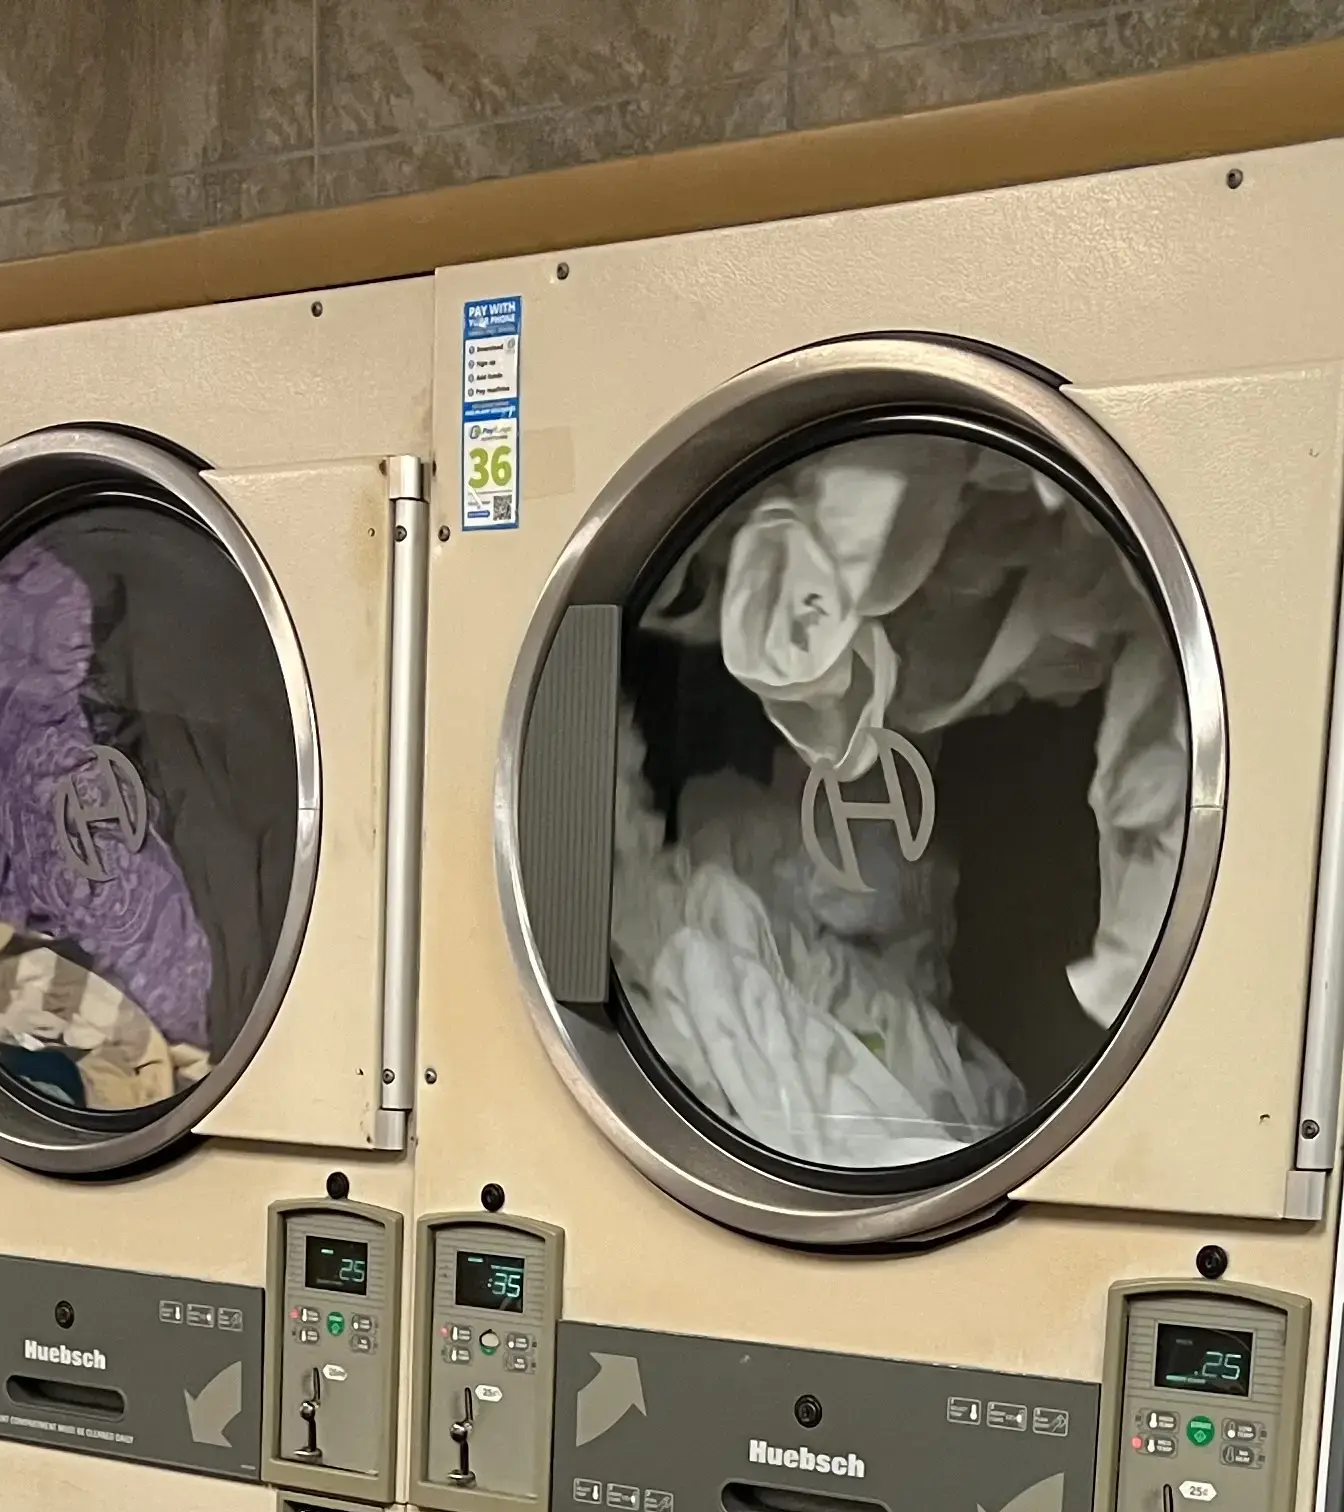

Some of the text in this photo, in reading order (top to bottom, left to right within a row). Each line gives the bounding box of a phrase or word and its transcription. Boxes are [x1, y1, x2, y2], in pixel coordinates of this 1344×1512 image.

[468, 301, 516, 318] PAY WITH
[468, 445, 512, 489] 36
[24, 1339, 106, 1370] Huebsch
[749, 1439, 865, 1478] Huebsch
